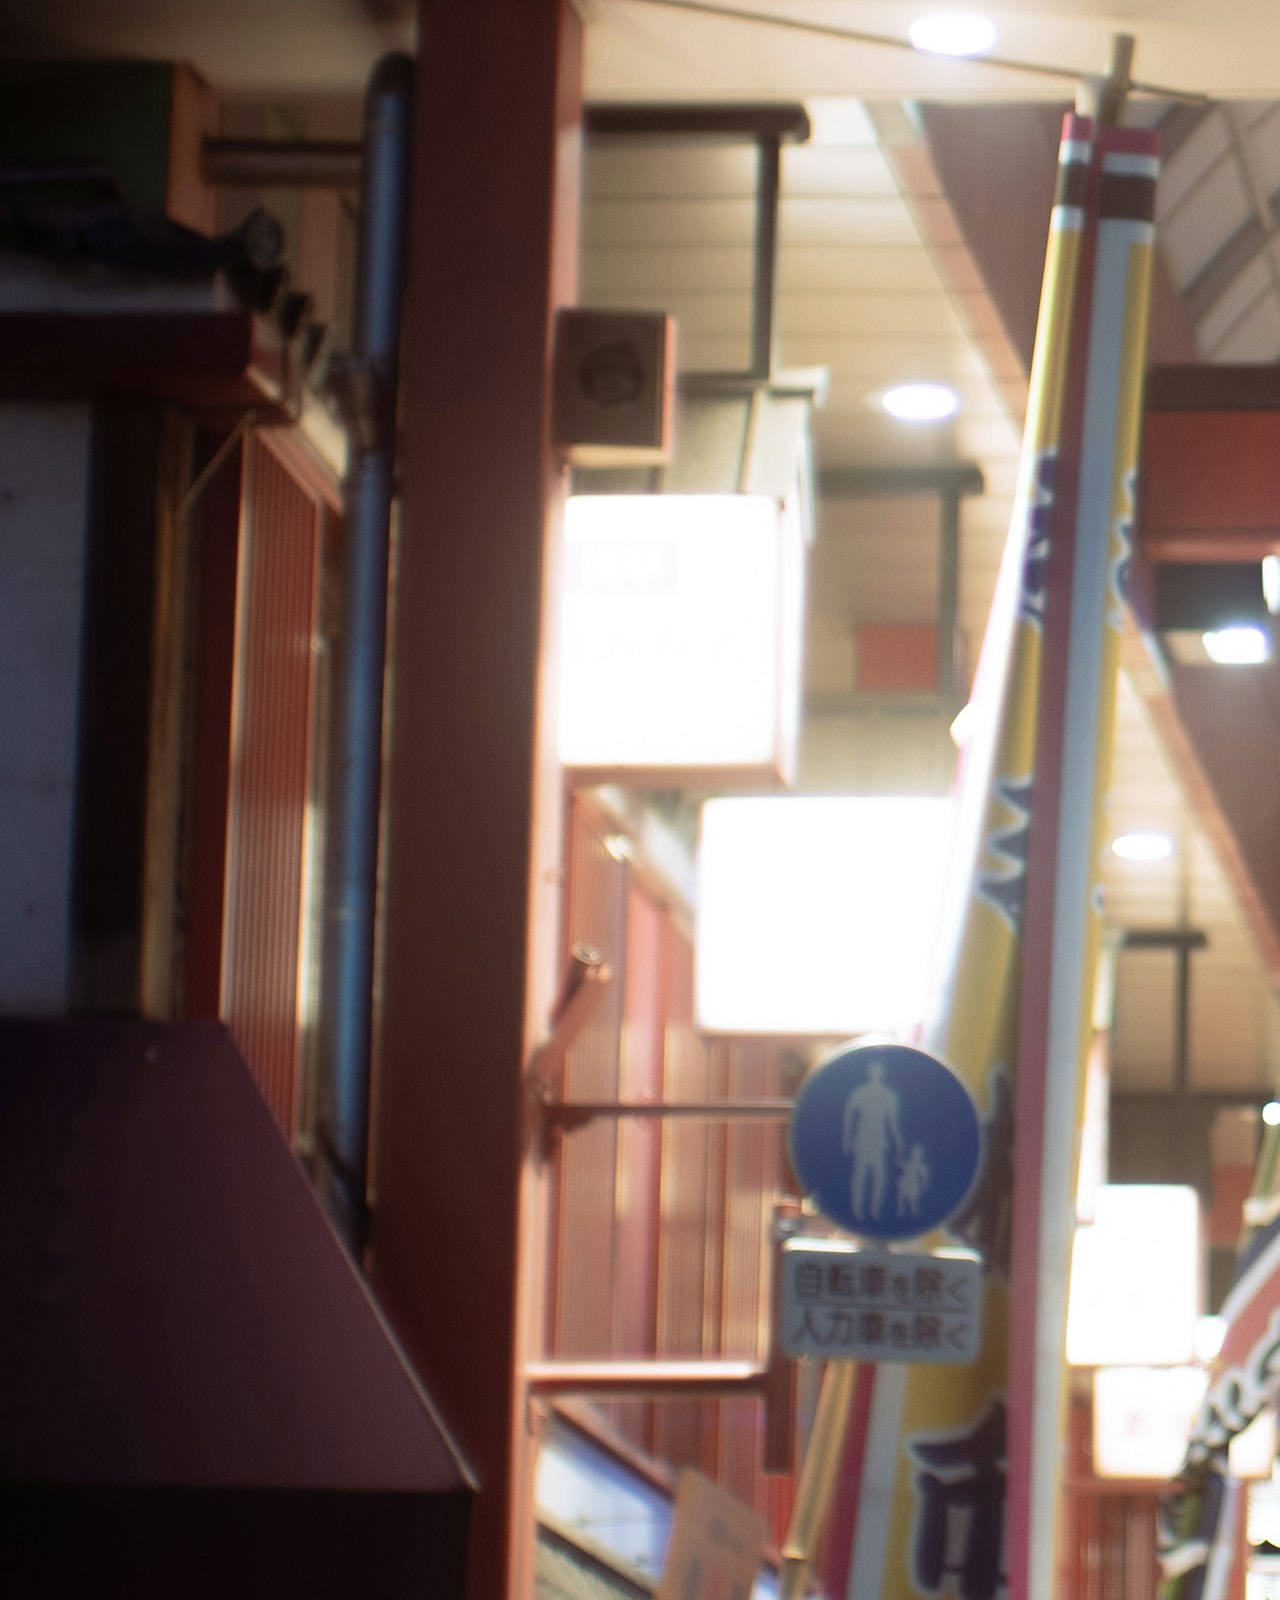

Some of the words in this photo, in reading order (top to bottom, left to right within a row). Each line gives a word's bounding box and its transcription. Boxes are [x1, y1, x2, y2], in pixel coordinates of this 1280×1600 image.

[794, 1262, 970, 1303] 自転車を除く
[792, 1308, 970, 1352] 人力車を除く
